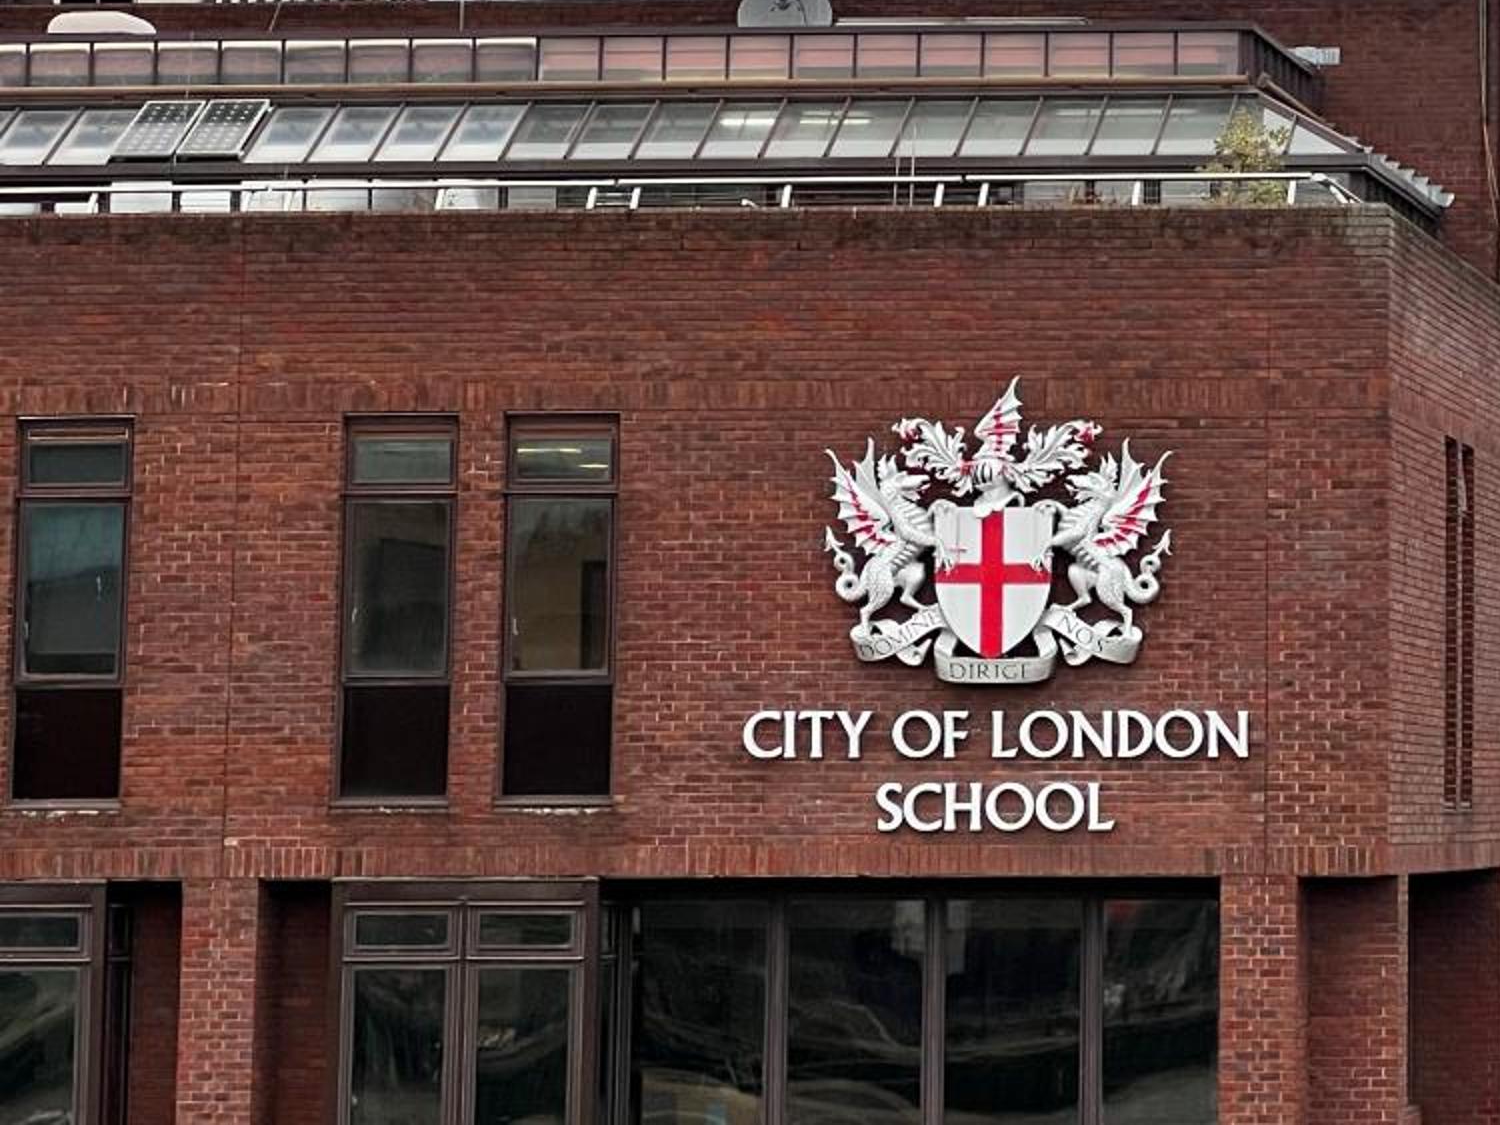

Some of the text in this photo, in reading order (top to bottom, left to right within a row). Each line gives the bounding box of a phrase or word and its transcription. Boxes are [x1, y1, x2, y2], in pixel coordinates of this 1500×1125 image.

[742, 709, 1250, 759] CITY OF LONDON
[875, 781, 1115, 831] SCHOOL
